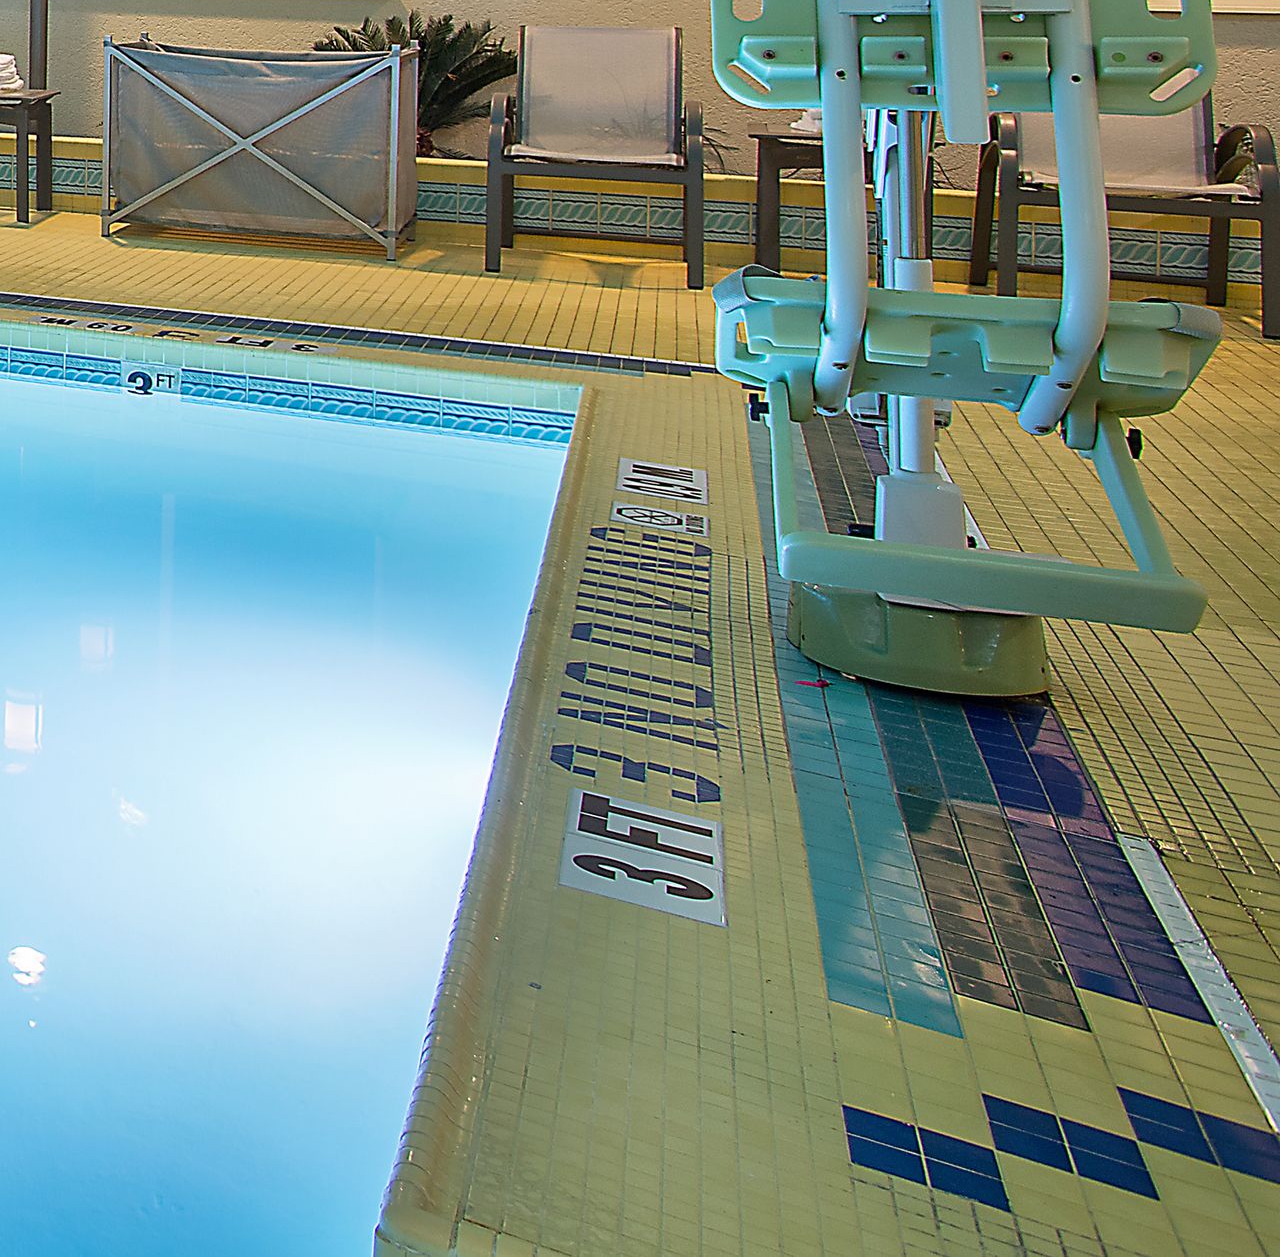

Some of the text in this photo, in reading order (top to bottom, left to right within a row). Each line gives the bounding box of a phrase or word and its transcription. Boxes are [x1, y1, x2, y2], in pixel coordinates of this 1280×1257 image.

[215, 336, 275, 348] FT
[155, 373, 175, 389] FT
[621, 475, 703, 500] 0.9
[570, 527, 713, 667] DIVING
[557, 661, 722, 752] NO
[572, 791, 715, 901] 3 FT
